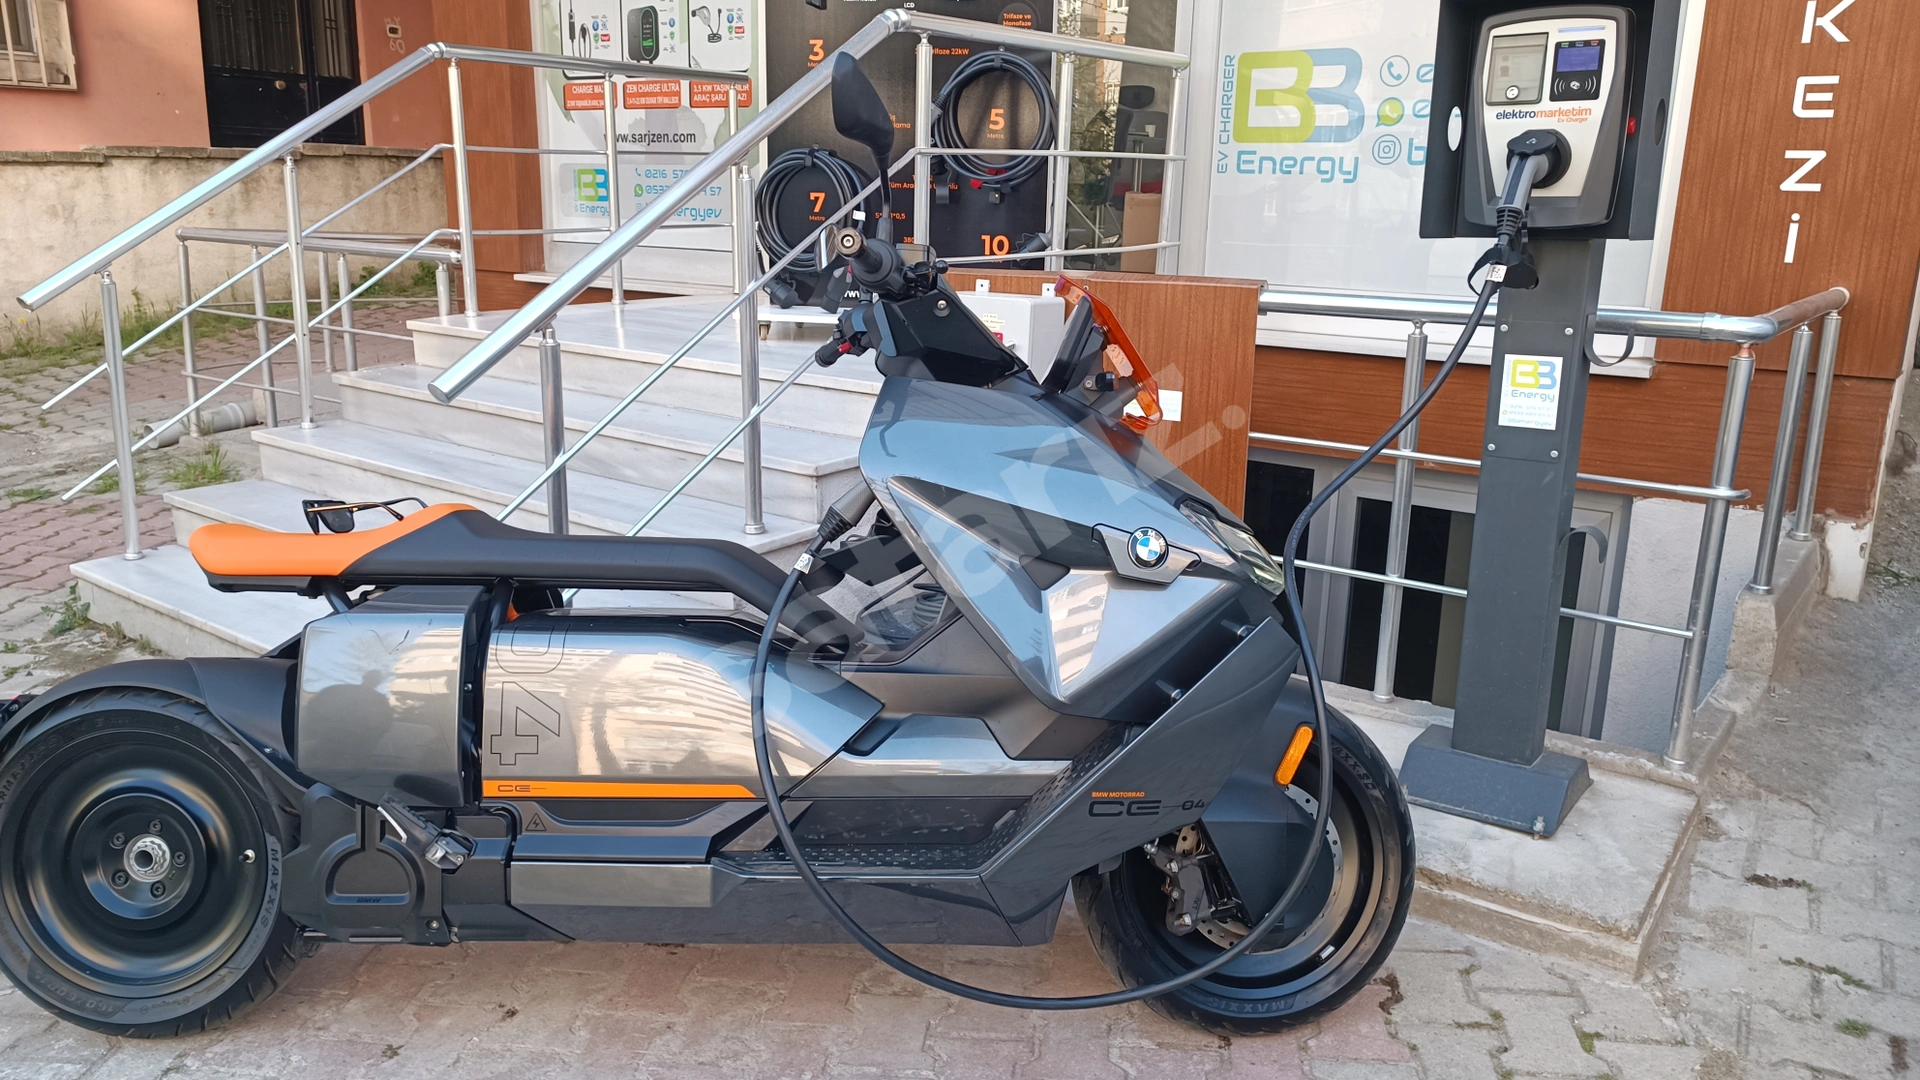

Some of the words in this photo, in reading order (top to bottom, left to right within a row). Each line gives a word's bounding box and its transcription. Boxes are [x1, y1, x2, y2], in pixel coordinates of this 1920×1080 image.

[808, 39, 825, 61] 3
[571, 85, 594, 94] CHARGE
[626, 84, 638, 93] ZEN
[638, 83, 661, 92] CHARGE
[661, 82, 680, 92] ULTRA
[1218, 54, 1236, 145] CHARGER
[988, 108, 1005, 131] 5
[1495, 106, 1592, 120] elektromarketim
[1216, 150, 1229, 174] EV
[1236, 150, 1360, 184] Energy
[644, 168, 668, 179] 0216
[709, 186, 722, 196] 57
[808, 192, 826, 213] 7
[980, 234, 1011, 256] 10
[1511, 389, 1555, 403] Energy
[1088, 800, 1162, 817] CE
